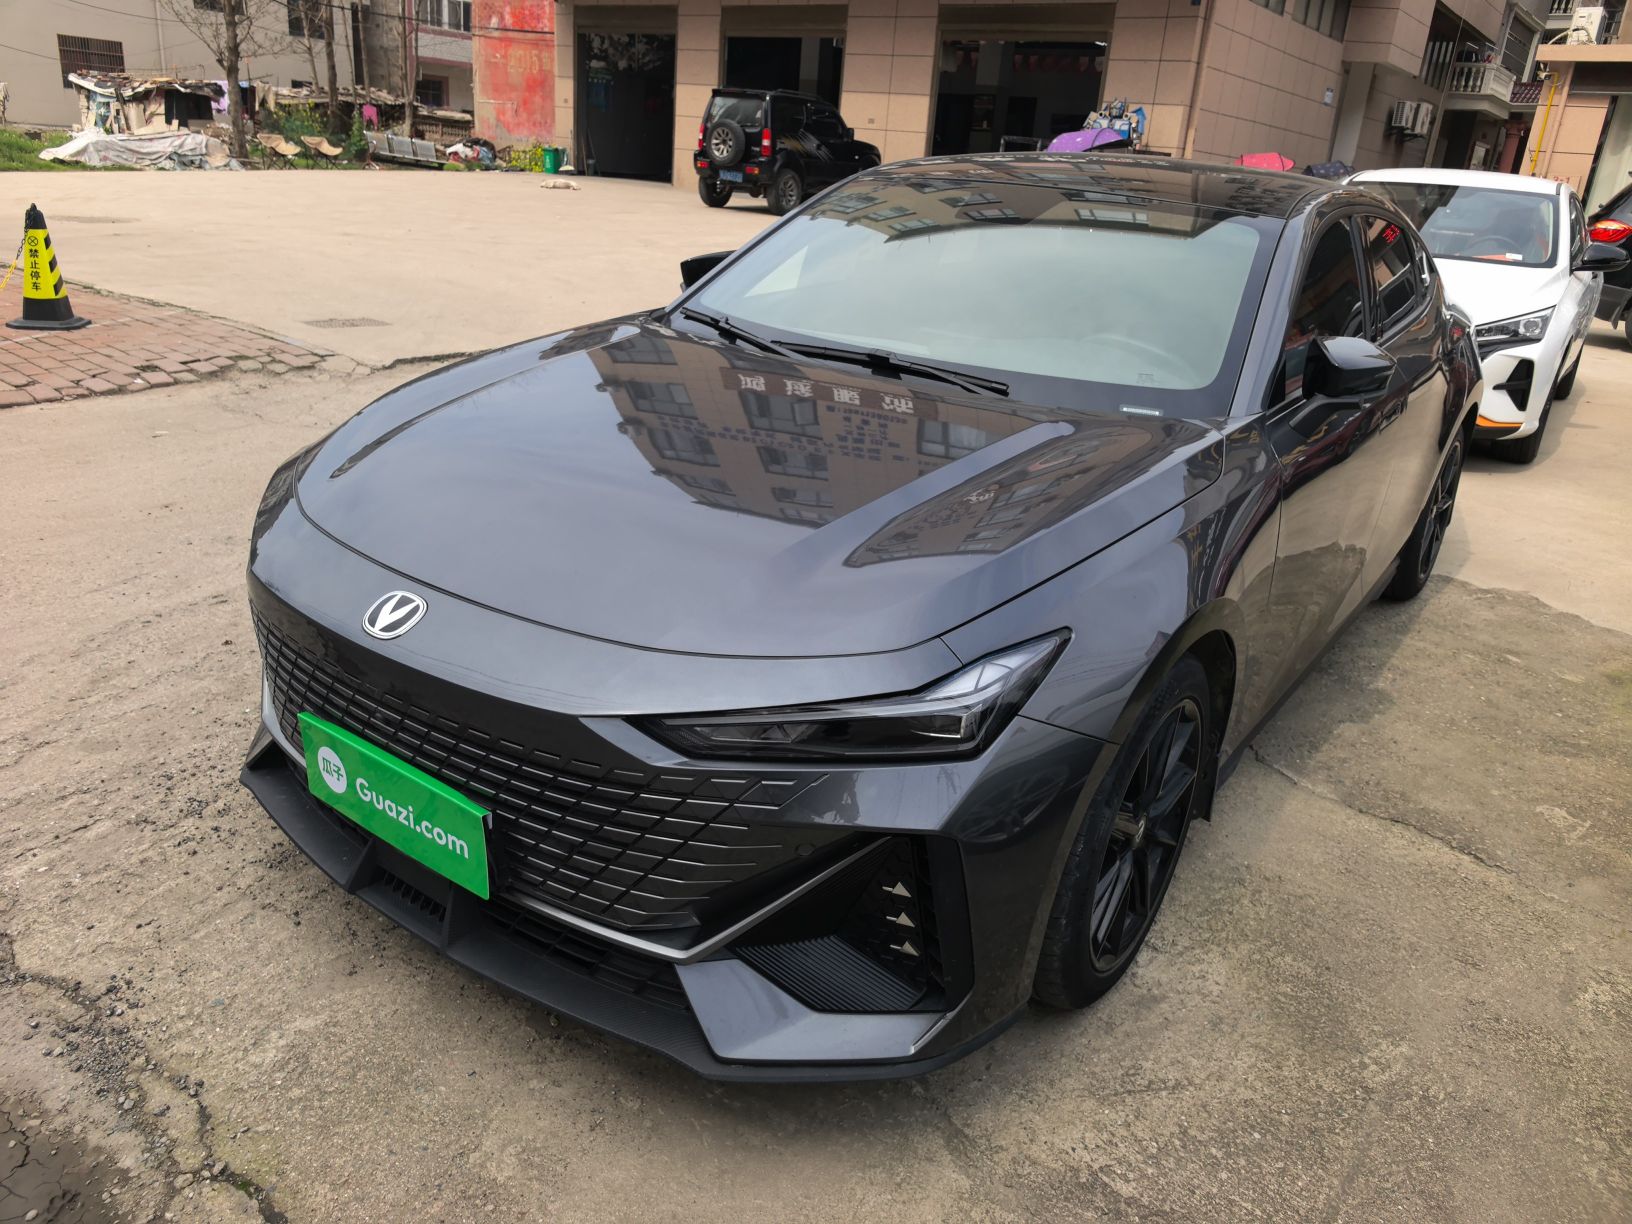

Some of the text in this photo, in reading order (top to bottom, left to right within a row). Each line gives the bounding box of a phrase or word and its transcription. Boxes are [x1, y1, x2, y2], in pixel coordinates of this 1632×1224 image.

[28, 248, 42, 292] 禁止停车
[322, 756, 344, 782] 瓜子
[355, 777, 470, 860] Guazi.com
